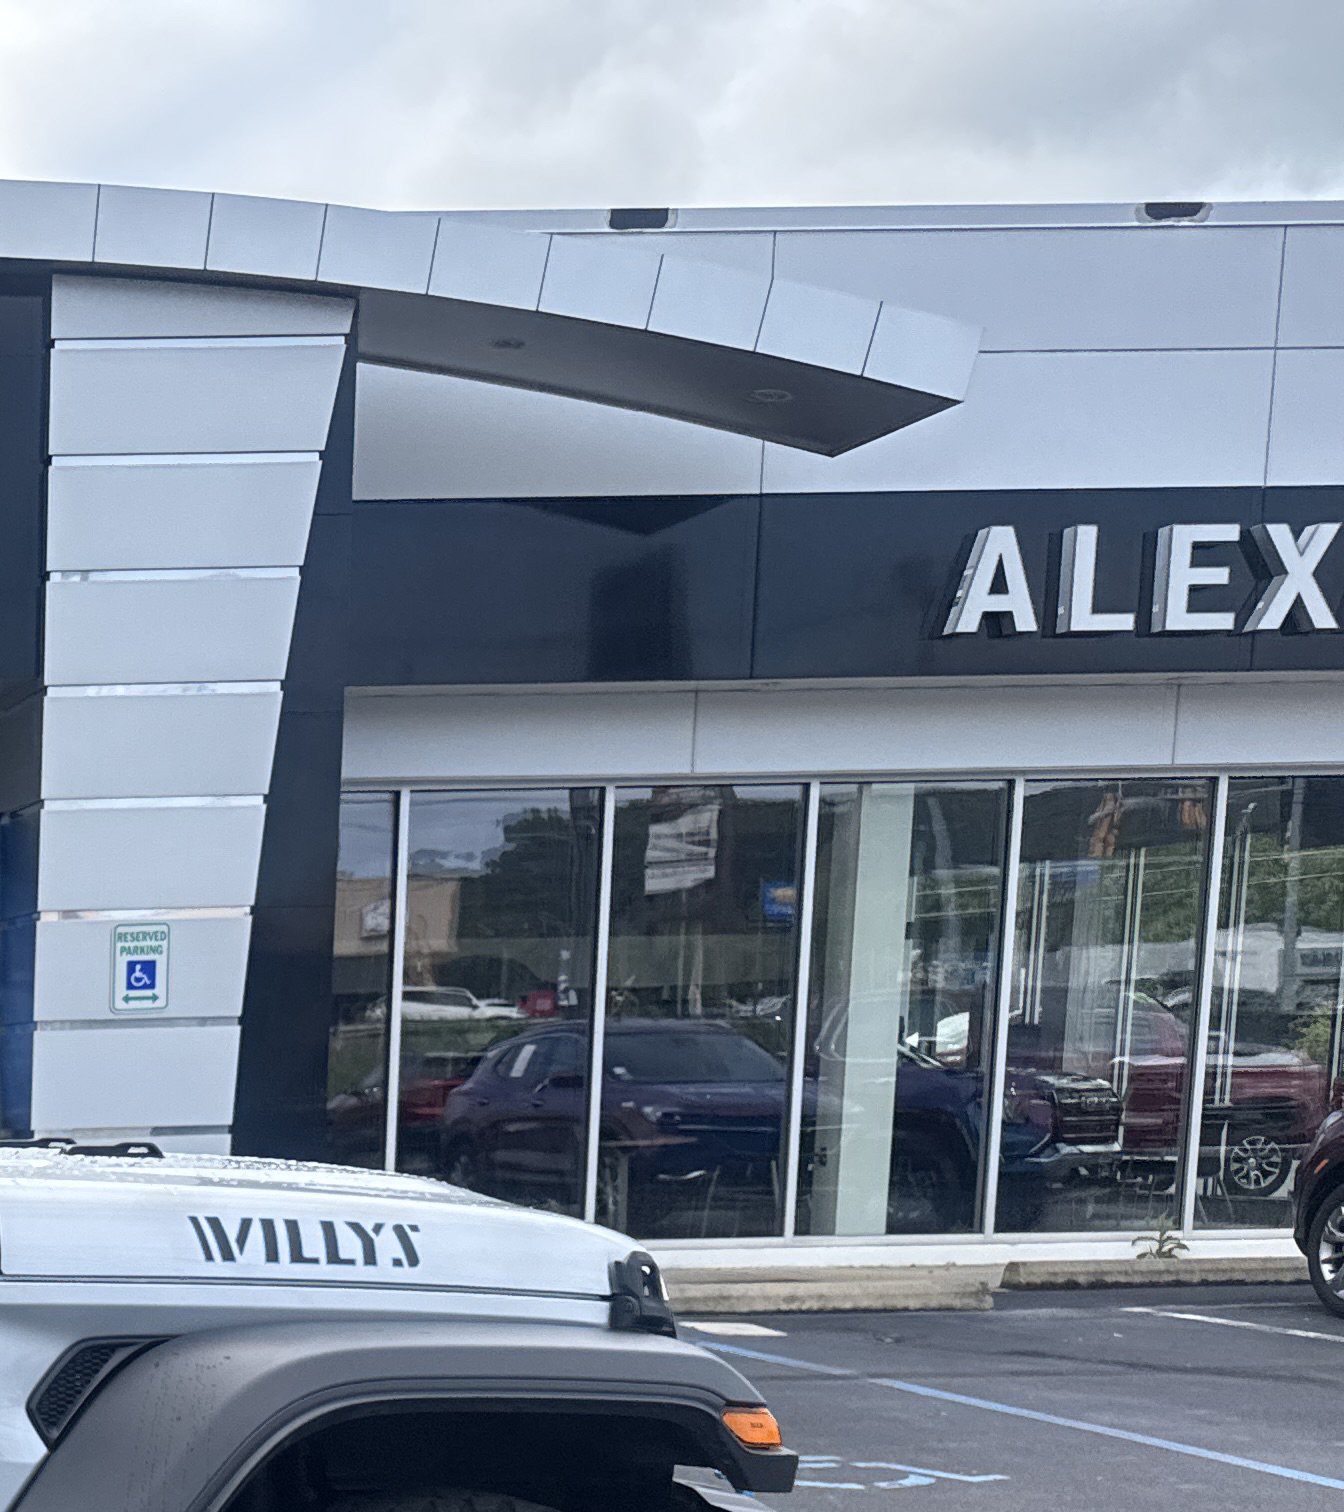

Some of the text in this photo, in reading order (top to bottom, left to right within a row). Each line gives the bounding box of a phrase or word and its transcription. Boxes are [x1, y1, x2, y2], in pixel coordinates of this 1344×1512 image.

[943, 523, 1342, 635] ALEX
[117, 931, 167, 942] RESERVED
[119, 945, 163, 956] PARKING
[187, 1215, 421, 1268] WILLYS
